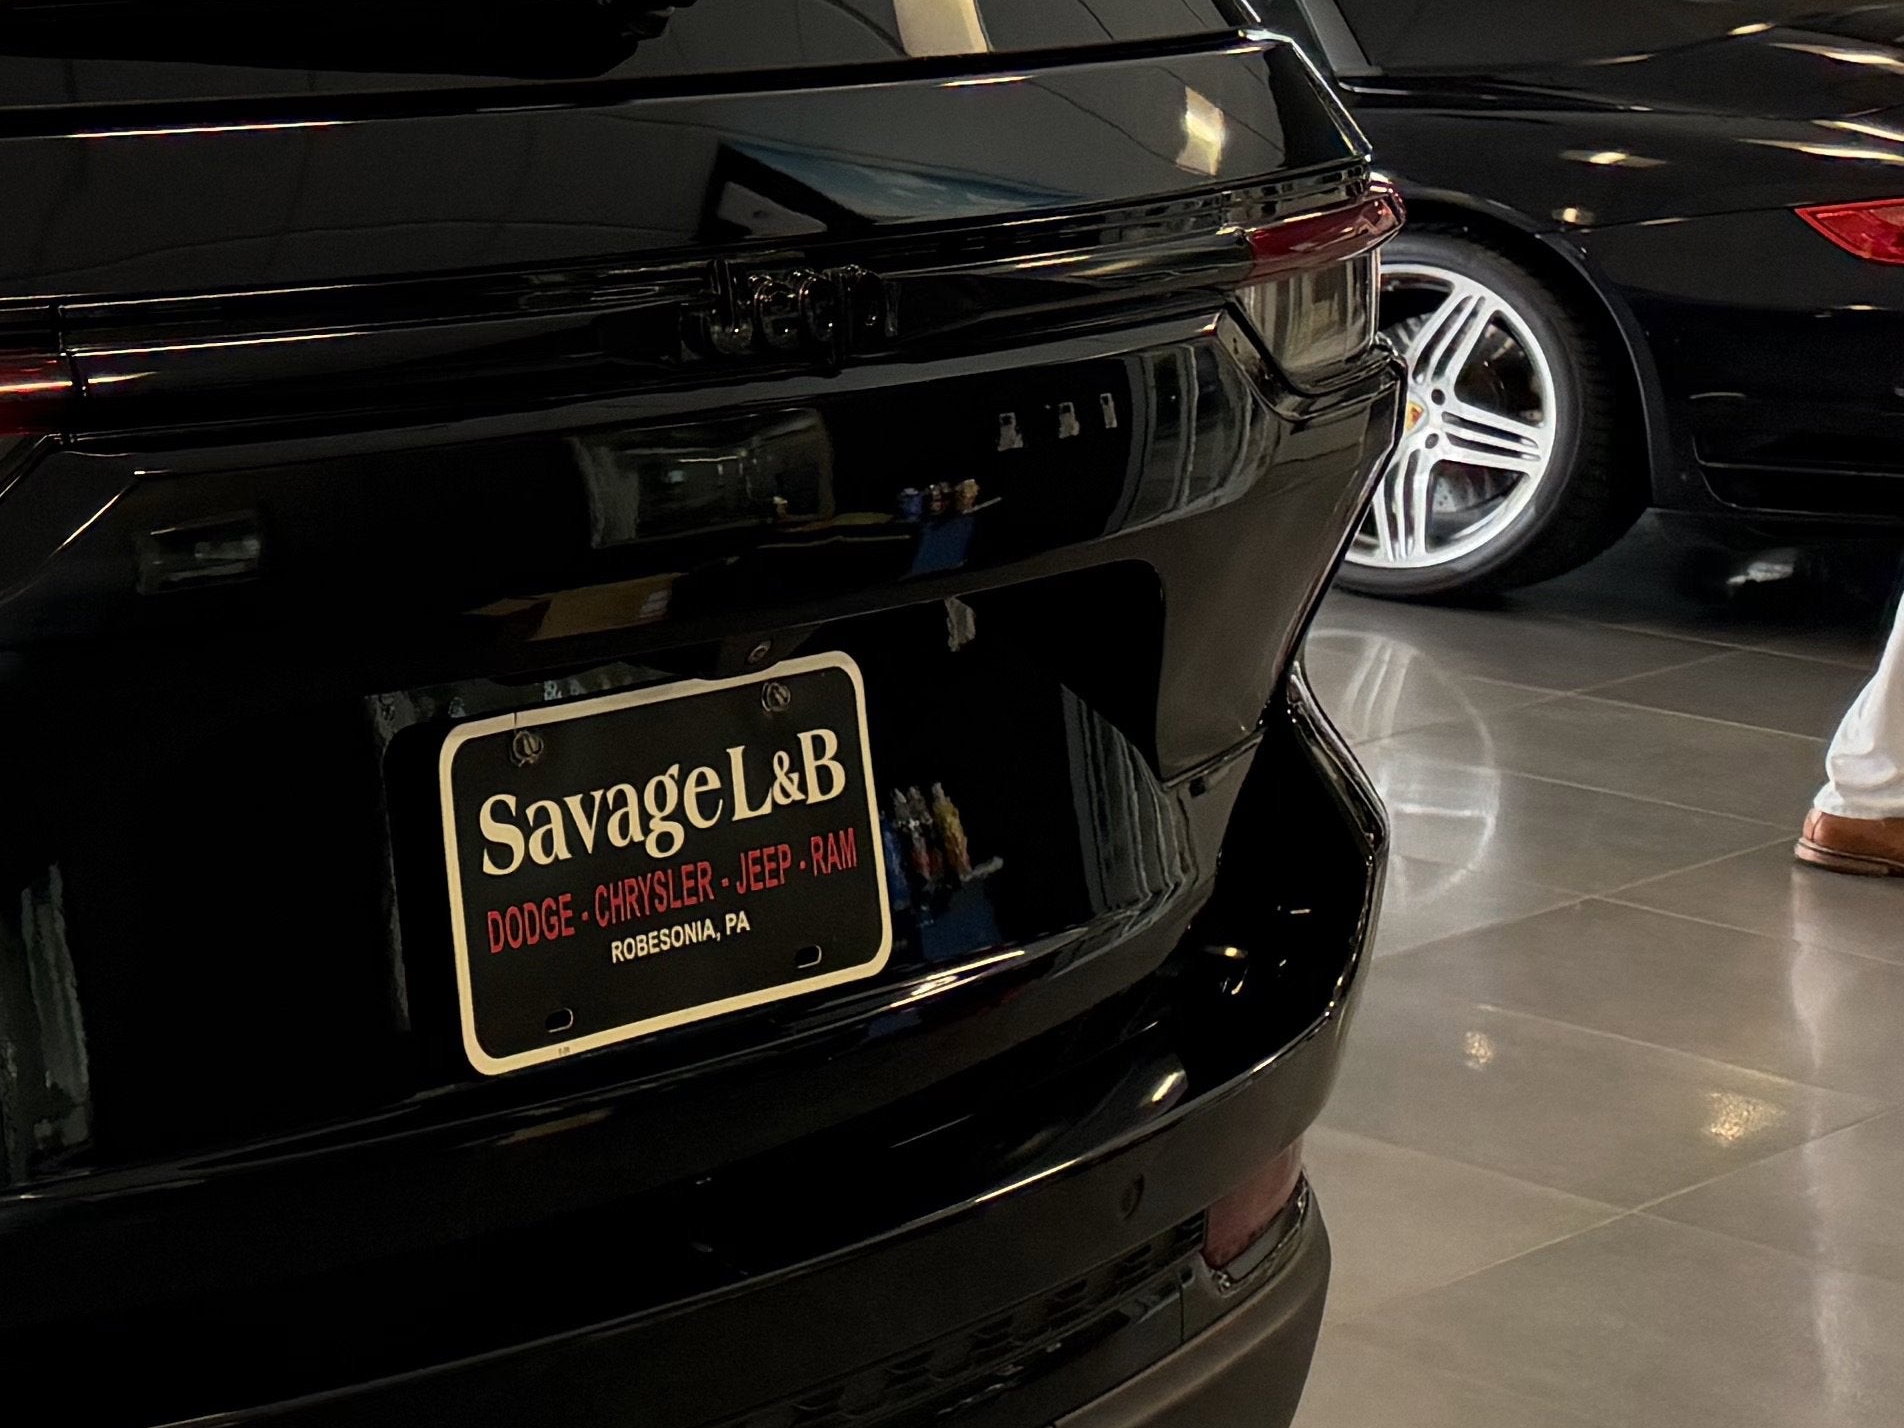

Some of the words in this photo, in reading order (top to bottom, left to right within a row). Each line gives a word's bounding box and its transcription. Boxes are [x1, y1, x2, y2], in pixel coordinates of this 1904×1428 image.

[487, 893, 576, 953] DODGE
[594, 860, 714, 929] CHRYSLER
[736, 843, 792, 896] JEEP
[810, 827, 857, 877] RAM
[610, 924, 721, 965] ROBESONIA,
[725, 911, 750, 944] PA
